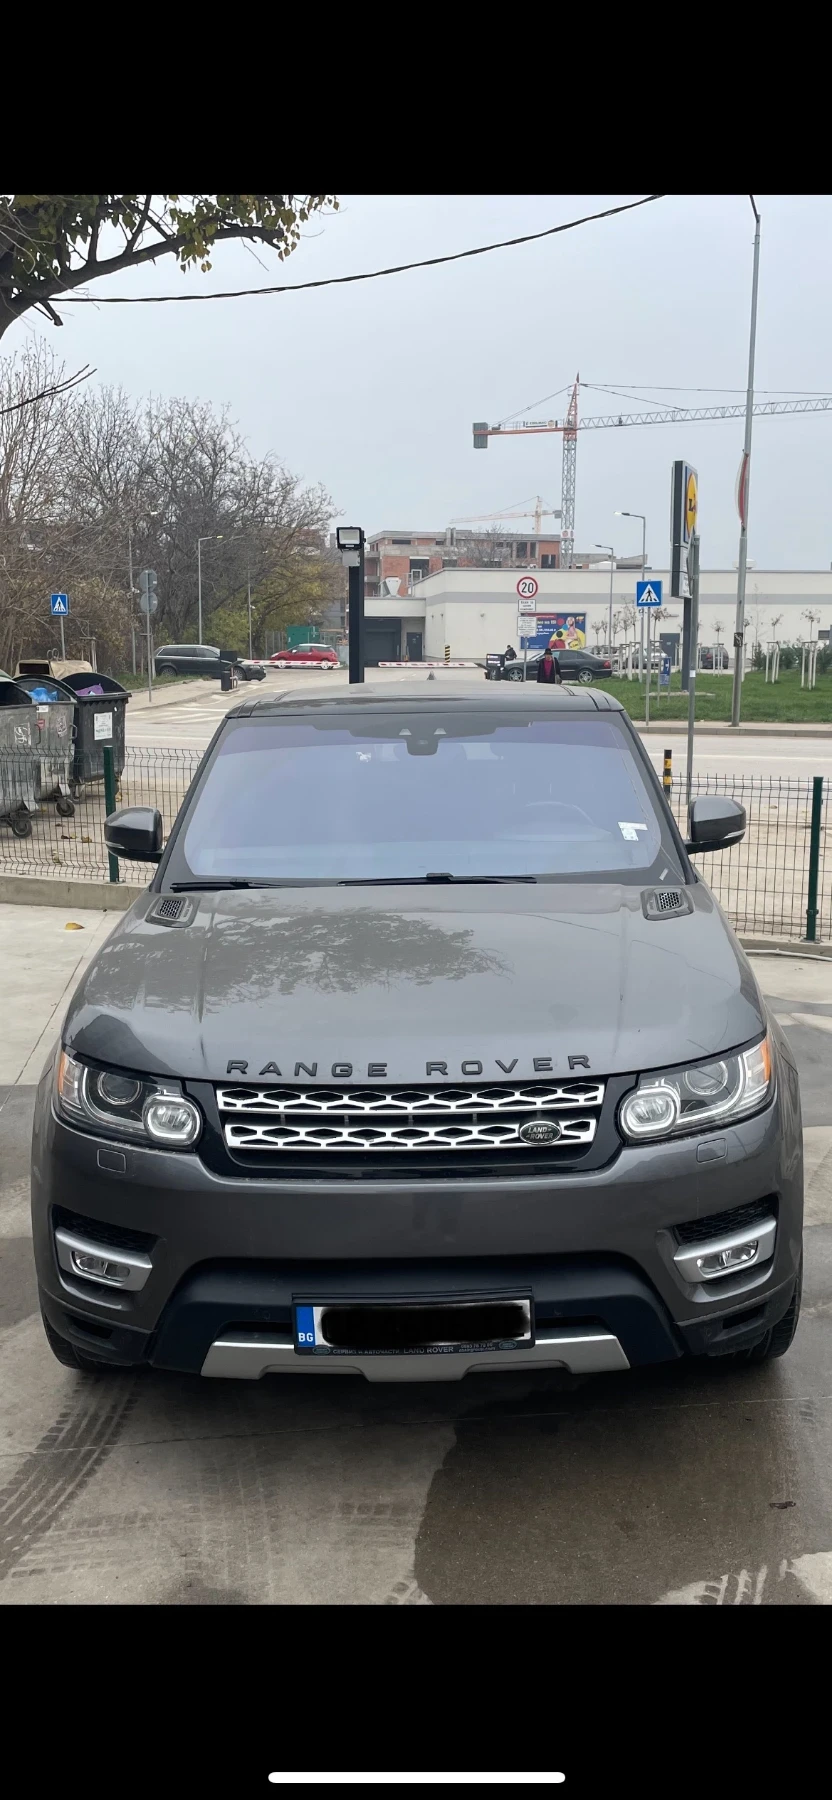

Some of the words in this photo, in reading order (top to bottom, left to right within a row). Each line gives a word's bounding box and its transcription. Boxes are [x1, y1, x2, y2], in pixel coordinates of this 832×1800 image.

[521, 582, 534, 593] 20
[226, 1059, 388, 1077] RANGE
[426, 1054, 591, 1076] ROVER
[298, 1332, 314, 1342] BG
[426, 1346, 454, 1354] ROVER
